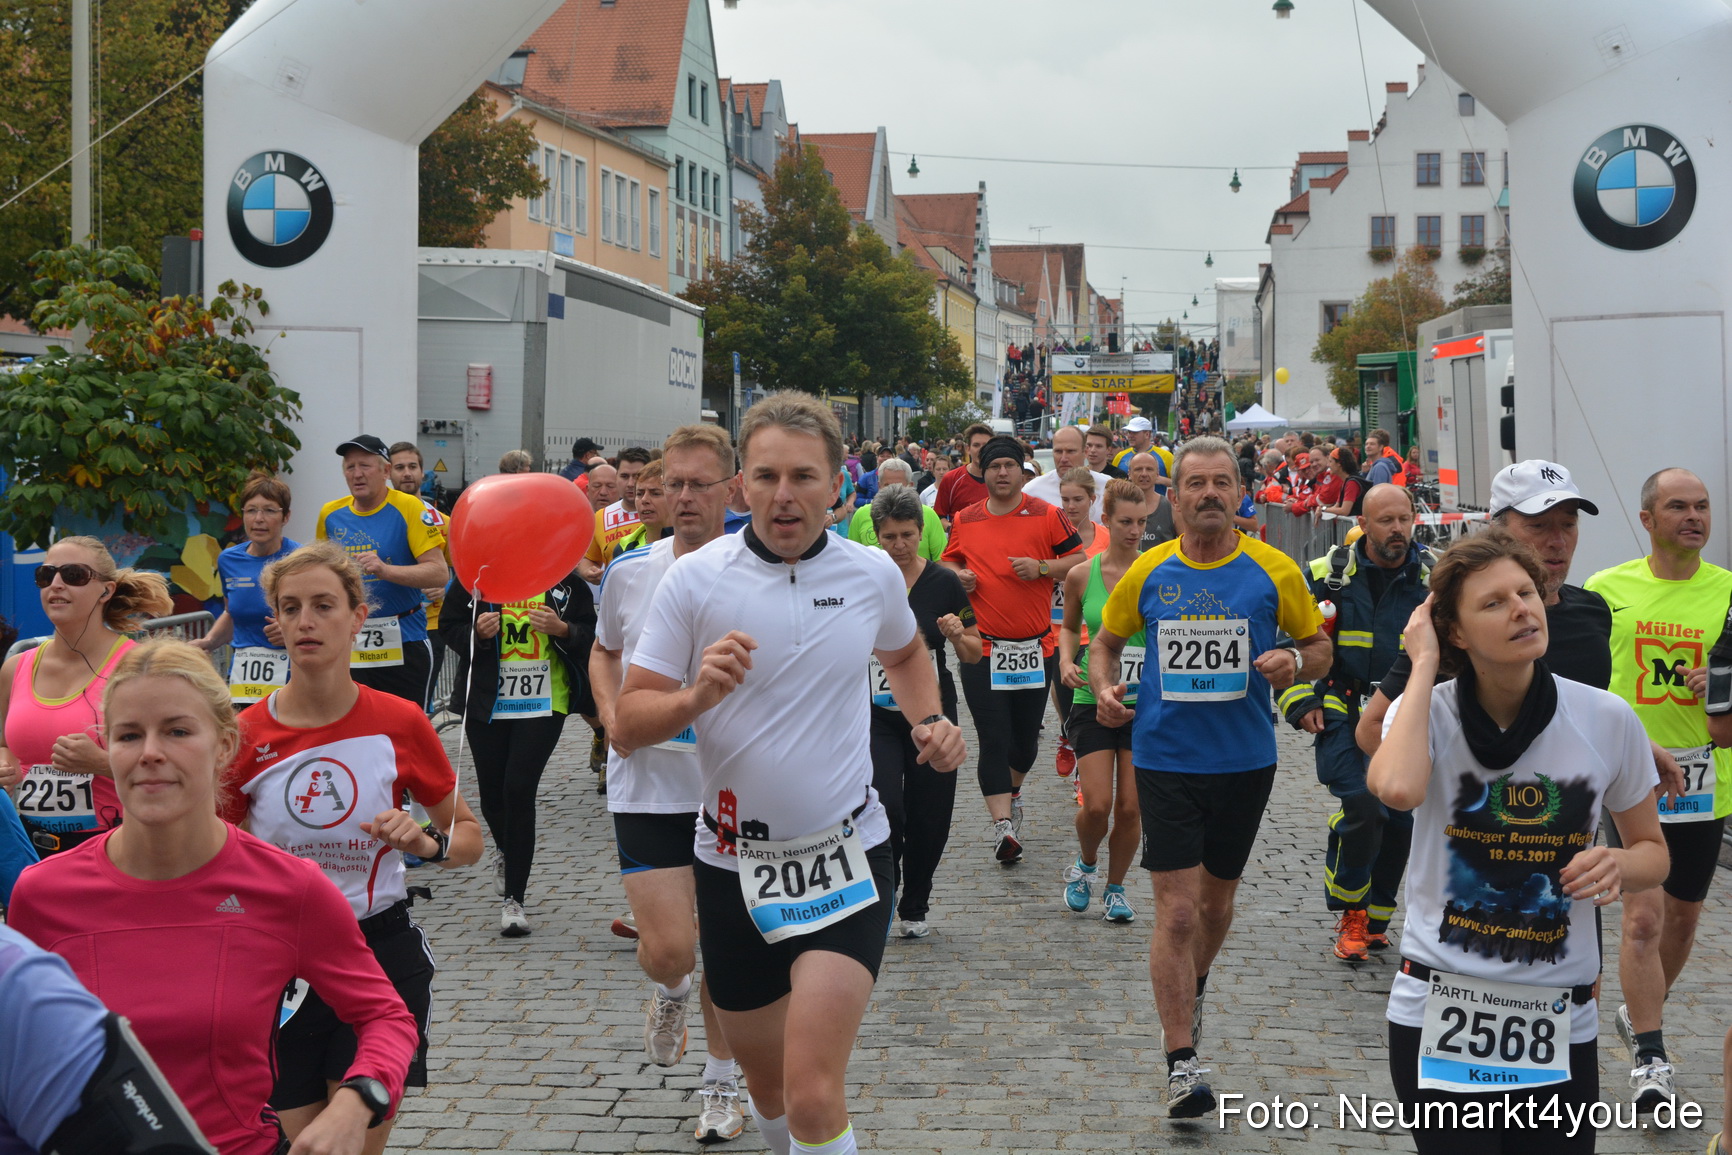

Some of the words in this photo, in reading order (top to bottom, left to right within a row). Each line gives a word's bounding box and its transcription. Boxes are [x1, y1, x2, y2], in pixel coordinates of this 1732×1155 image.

[1583, 128, 1688, 170] BMW
[233, 153, 325, 192] BMW
[669, 347, 697, 390] BOCK
[1092, 378, 1134, 388] START
[813, 597, 844, 607] kalas
[361, 630, 384, 648] 73
[506, 623, 531, 645] M
[1160, 628, 1188, 637] PARTL
[1190, 628, 1232, 637] Neumarkt
[1635, 621, 1704, 639] Müller
[359, 652, 388, 661] Richard
[996, 651, 1039, 671] 2536
[1168, 640, 1241, 670] 2264
[241, 660, 274, 682] 106
[510, 665, 539, 673] Neumarkt
[1006, 674, 1031, 683] Florian
[1652, 658, 1687, 687] M
[244, 686, 262, 695] Erika
[499, 674, 545, 696] 2787
[1191, 678, 1216, 690] Karl
[498, 702, 542, 712] Dominique
[19, 779, 94, 811] 2251
[1444, 824, 1505, 844] Amberger
[1509, 830, 1564, 847] Running
[740, 848, 781, 861] PARTL
[783, 834, 839, 859] Neumarkt
[1489, 848, 1556, 861] 18.05.2013
[754, 844, 854, 900] 2041
[215, 905, 246, 914] adidas
[780, 894, 846, 922] Michael
[1432, 984, 1479, 1002] PARTL
[1483, 992, 1548, 1012] Neumarkt
[1436, 1006, 1556, 1065] 2568
[1468, 1068, 1519, 1083] Karin
